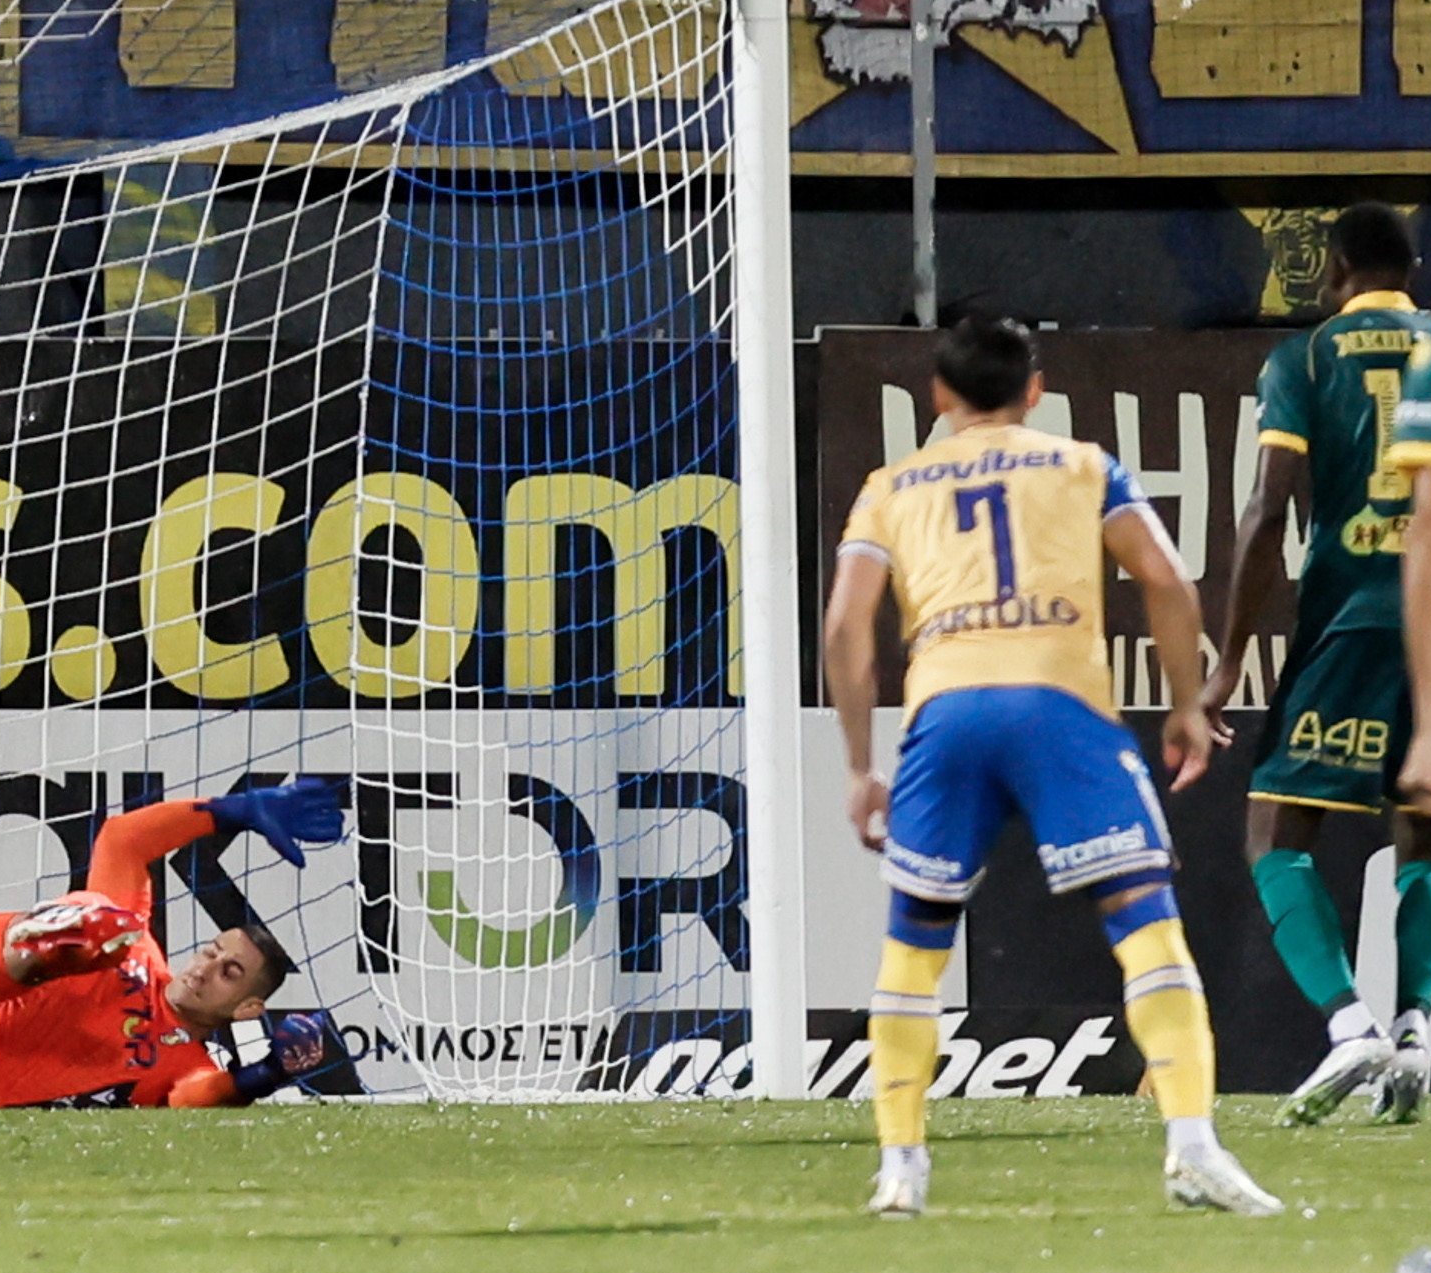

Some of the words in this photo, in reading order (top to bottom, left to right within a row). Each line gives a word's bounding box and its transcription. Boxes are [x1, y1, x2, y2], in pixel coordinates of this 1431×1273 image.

[893, 449, 1068, 491] novibet
[954, 480, 1016, 601] 7
[1289, 710, 1388, 760] A4B
[338, 1024, 527, 1062] ΟΜΙΛΟΣ
